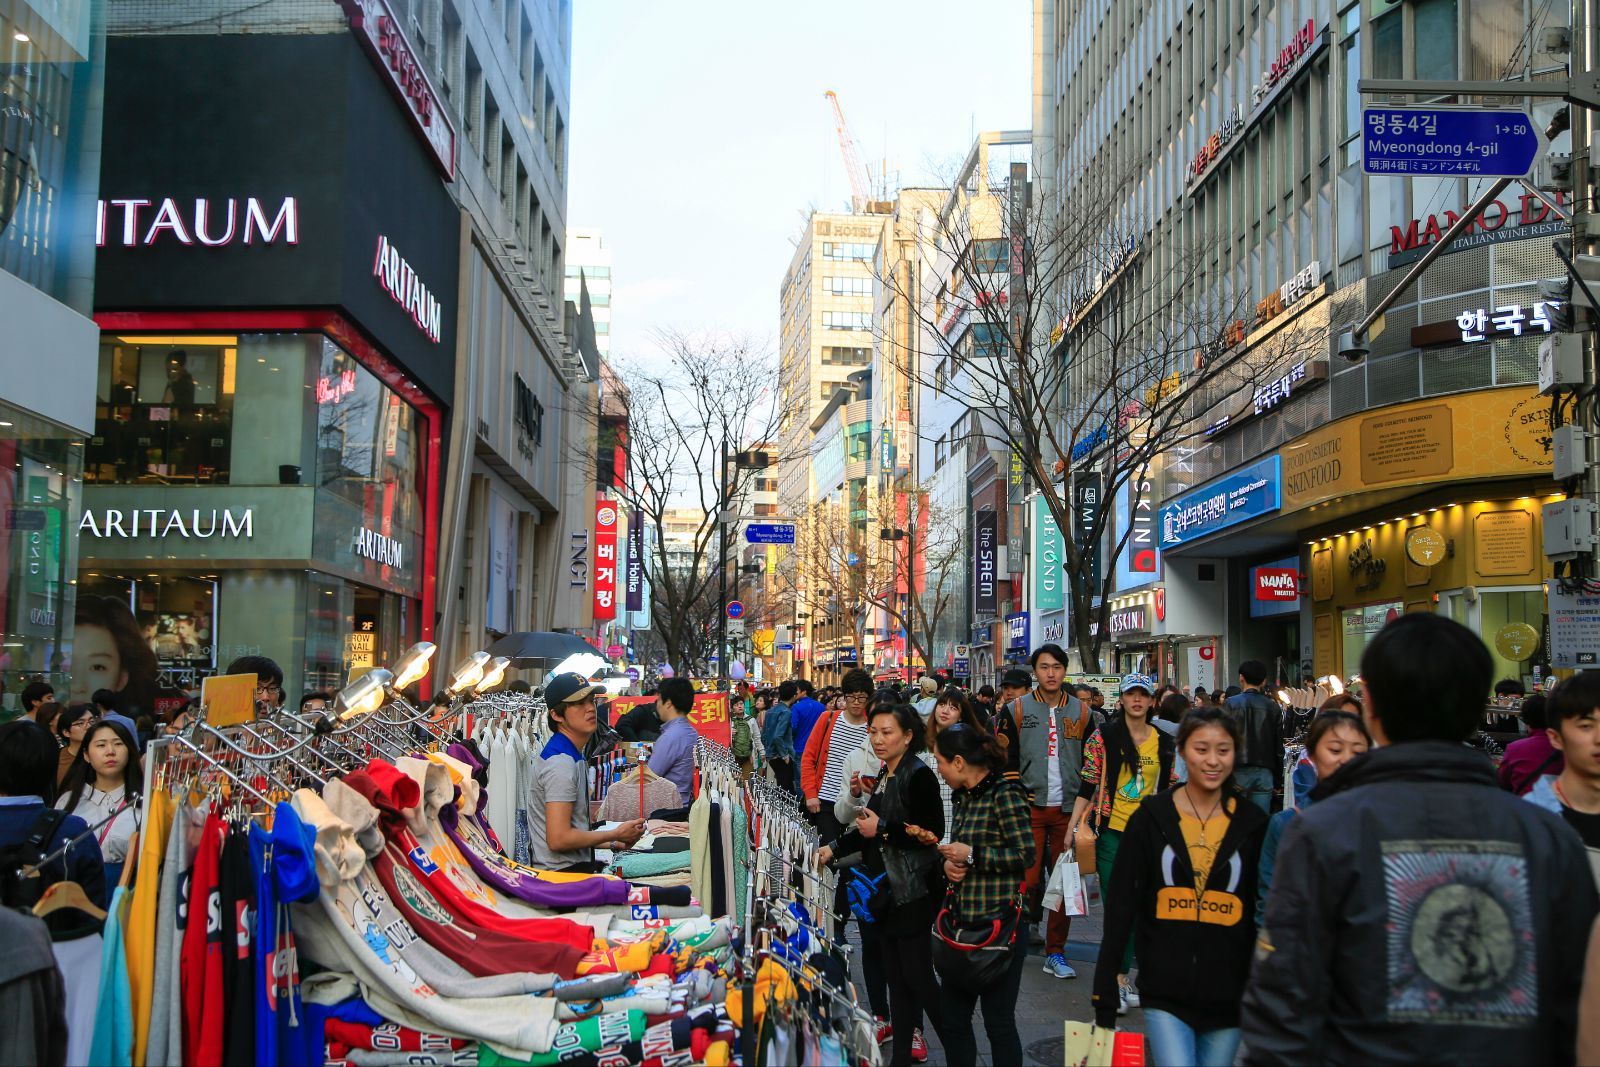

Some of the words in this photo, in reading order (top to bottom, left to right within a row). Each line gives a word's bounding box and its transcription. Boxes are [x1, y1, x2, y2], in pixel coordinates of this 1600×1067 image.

[1369, 114, 1437, 136] 명동4길
[1513, 125, 1526, 135] 50
[1369, 140, 1462, 156] Myeongdong
[1465, 142, 1498, 156] 4-gil
[1369, 160, 1408, 170] 明洞4街
[1453, 231, 1495, 249] ITALIAN
[1499, 226, 1528, 240] WINE
[374, 234, 441, 343] ARITAUM
[1520, 408, 1553, 425] SKIN
[1305, 437, 1342, 463] COSMETIC
[1287, 459, 1342, 496] SKINFOOD
[78, 508, 254, 538] ARITAUM
[358, 528, 402, 569] ARITAUM
[1044, 514, 1056, 592] BEYOND
[597, 544, 614, 608] 버거킹
[628, 562, 640, 593] Holika
[1260, 573, 1295, 589] NANTA
[362, 621, 373, 631] 2F
[1063, 717, 1083, 739] M
